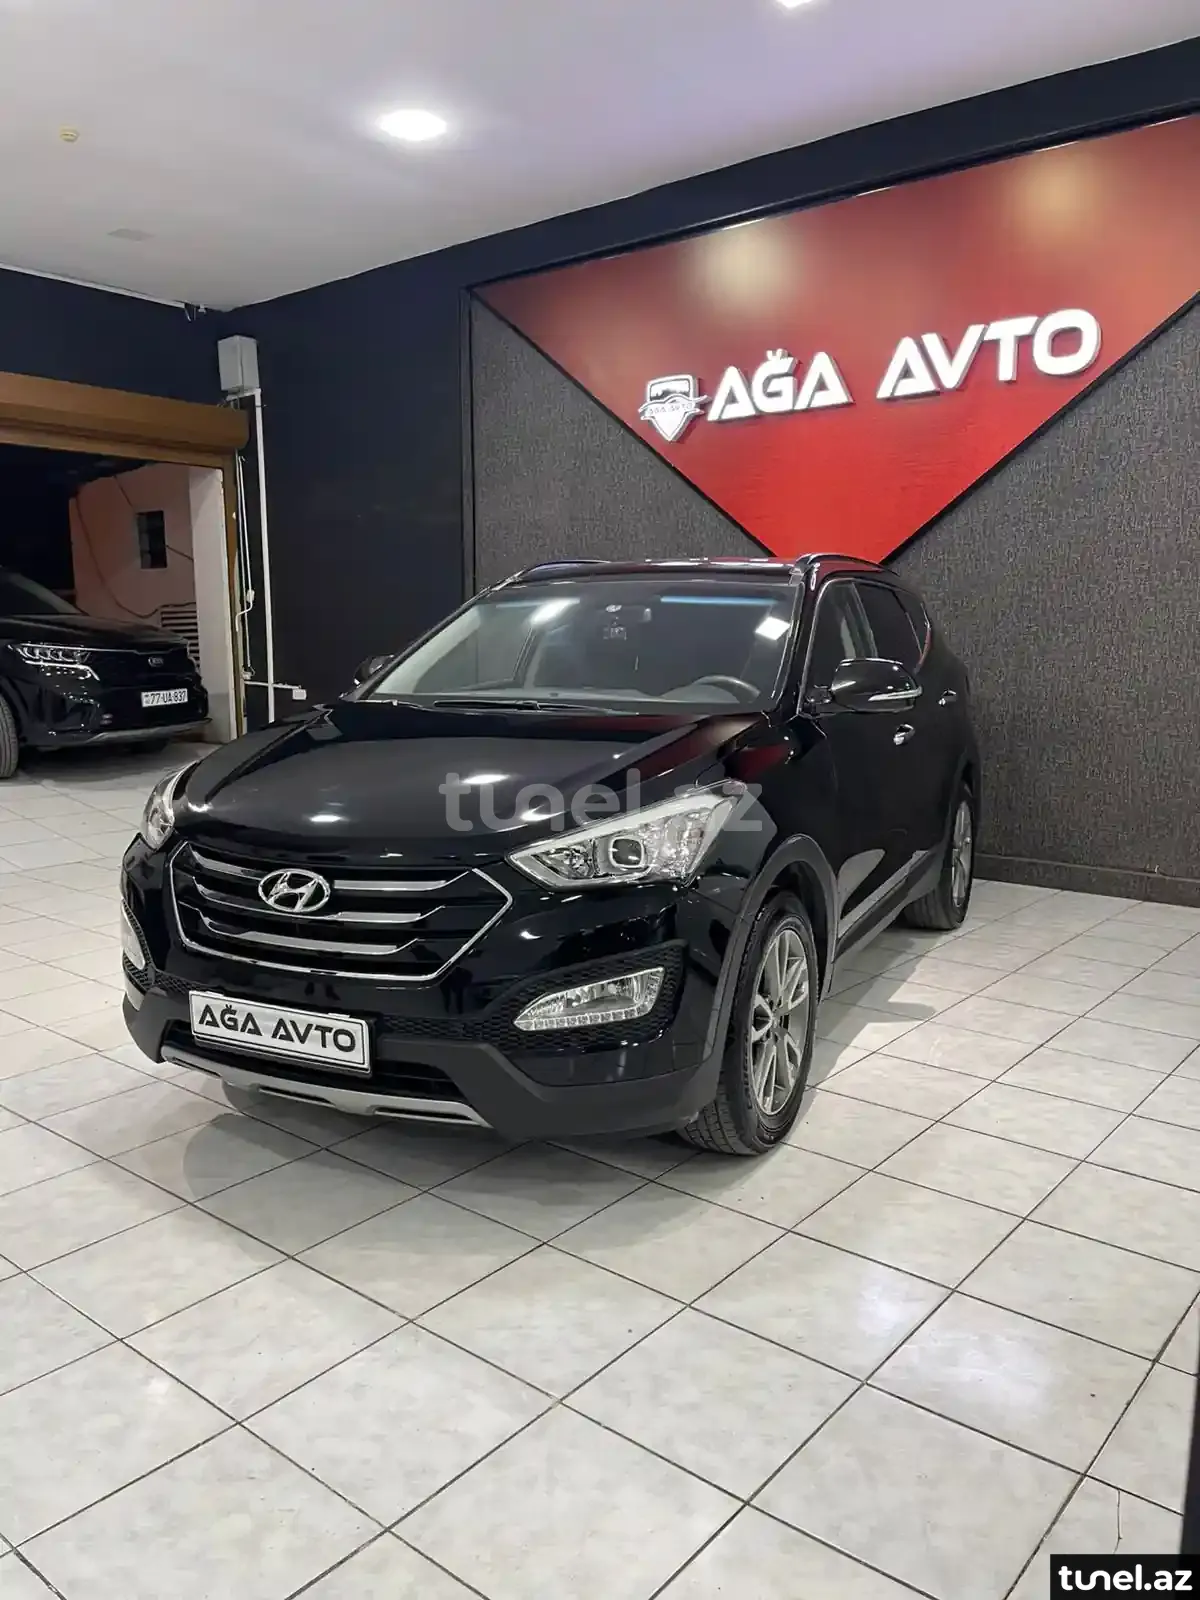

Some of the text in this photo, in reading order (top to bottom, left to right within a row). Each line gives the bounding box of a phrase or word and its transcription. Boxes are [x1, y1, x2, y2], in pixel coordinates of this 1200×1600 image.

[707, 308, 1102, 422] AĞA AVTO
[199, 1004, 356, 1053] AĞA AVTO
